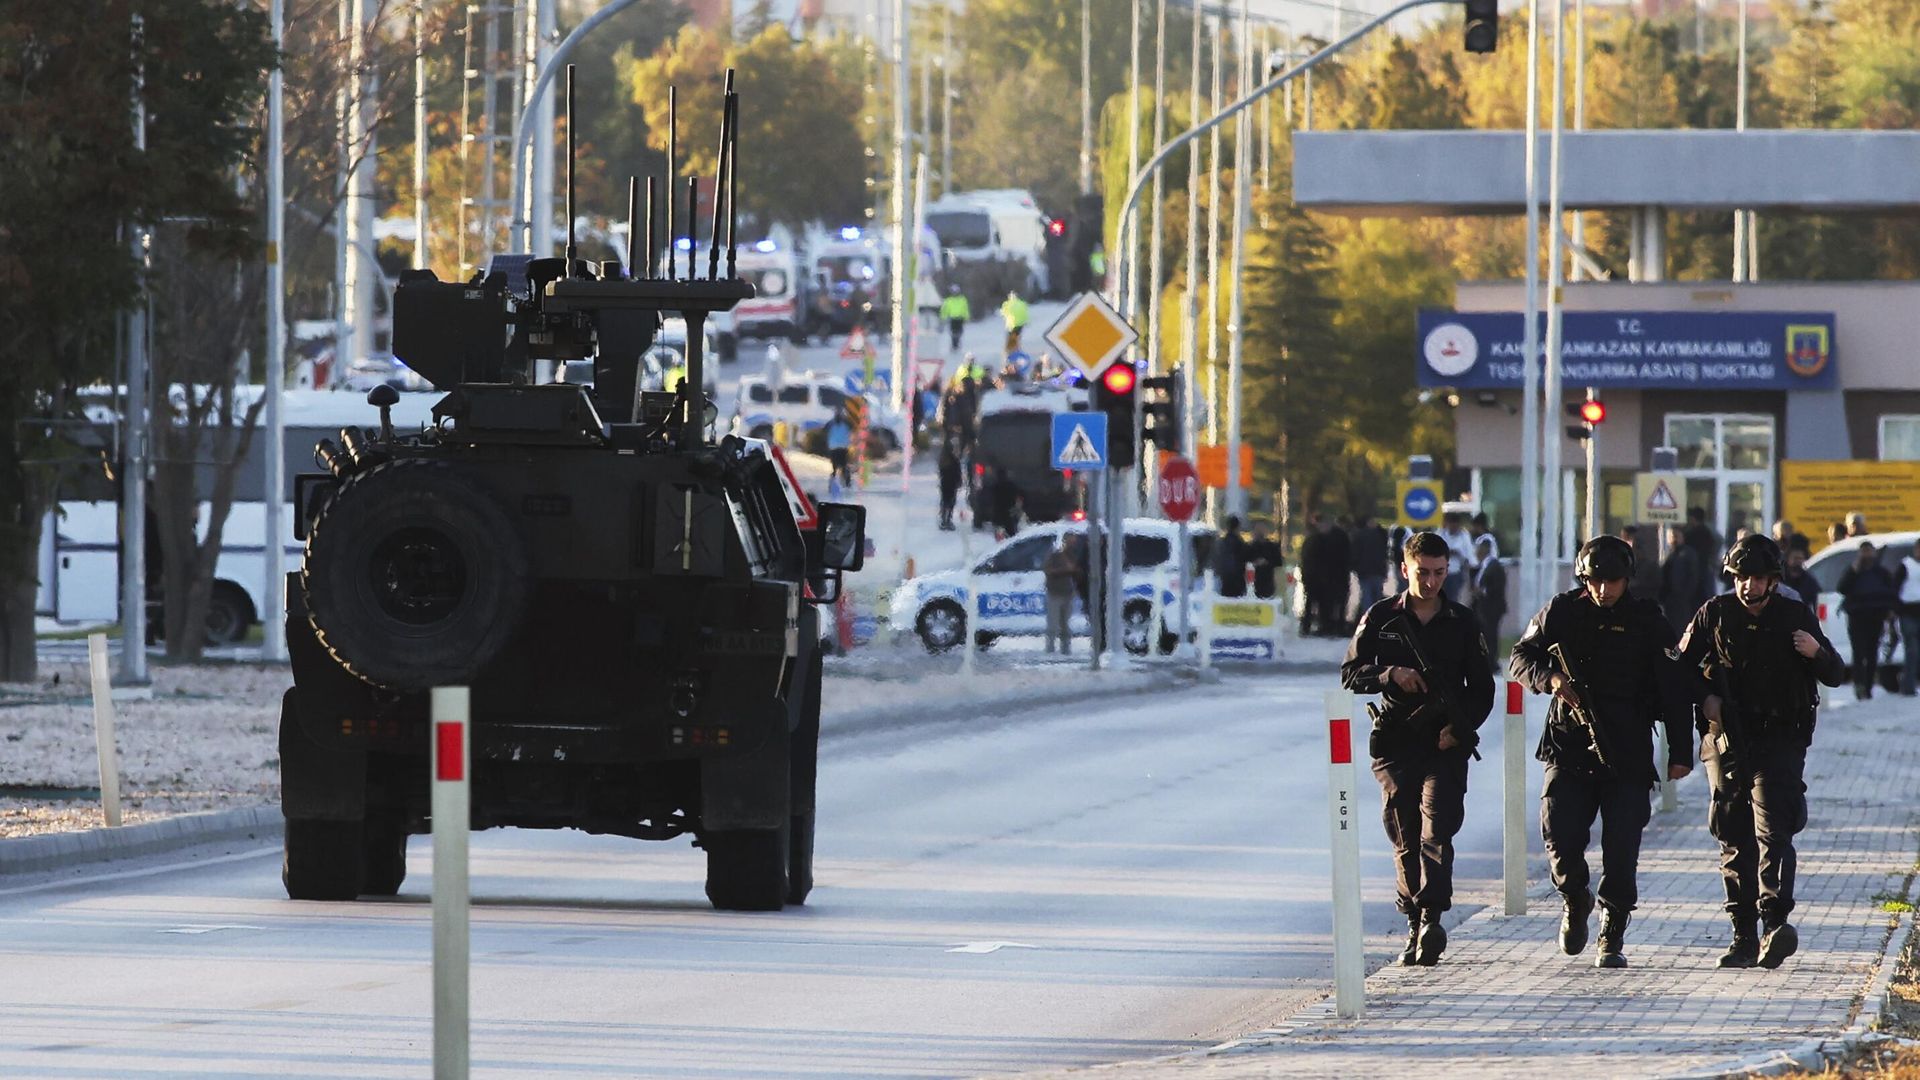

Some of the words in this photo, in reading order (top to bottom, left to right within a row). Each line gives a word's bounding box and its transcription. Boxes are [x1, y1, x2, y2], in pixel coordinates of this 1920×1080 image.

[1617, 318, 1645, 335] T.C.
[1645, 338, 1772, 358] KAYMAKAMLIĞI
[1160, 476, 1196, 504] DUR
[1339, 790, 1348, 830] KGM
